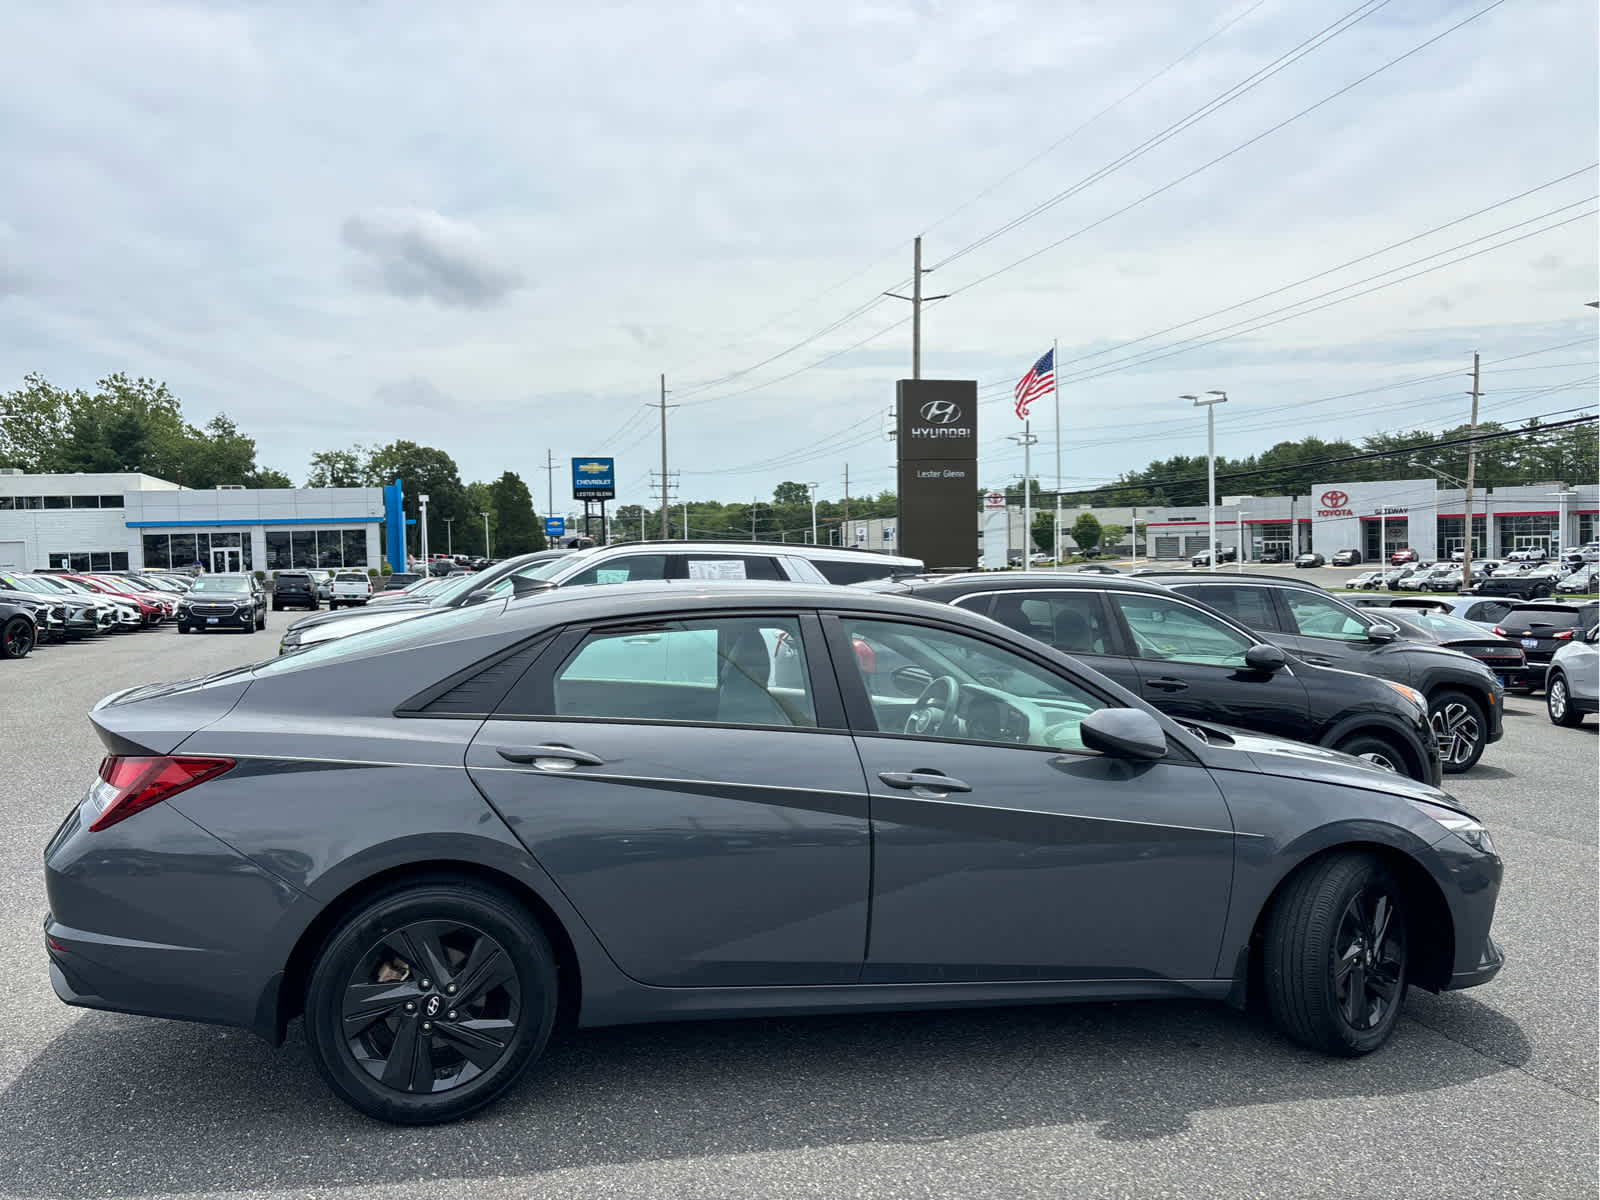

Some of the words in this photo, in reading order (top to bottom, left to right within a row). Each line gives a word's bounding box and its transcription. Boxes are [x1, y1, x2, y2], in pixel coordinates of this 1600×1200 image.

[911, 427, 971, 439] HYUNDAI
[916, 469, 941, 479] Lester
[943, 469, 966, 479] Glenn
[1317, 509, 1353, 517] TOYOTA
